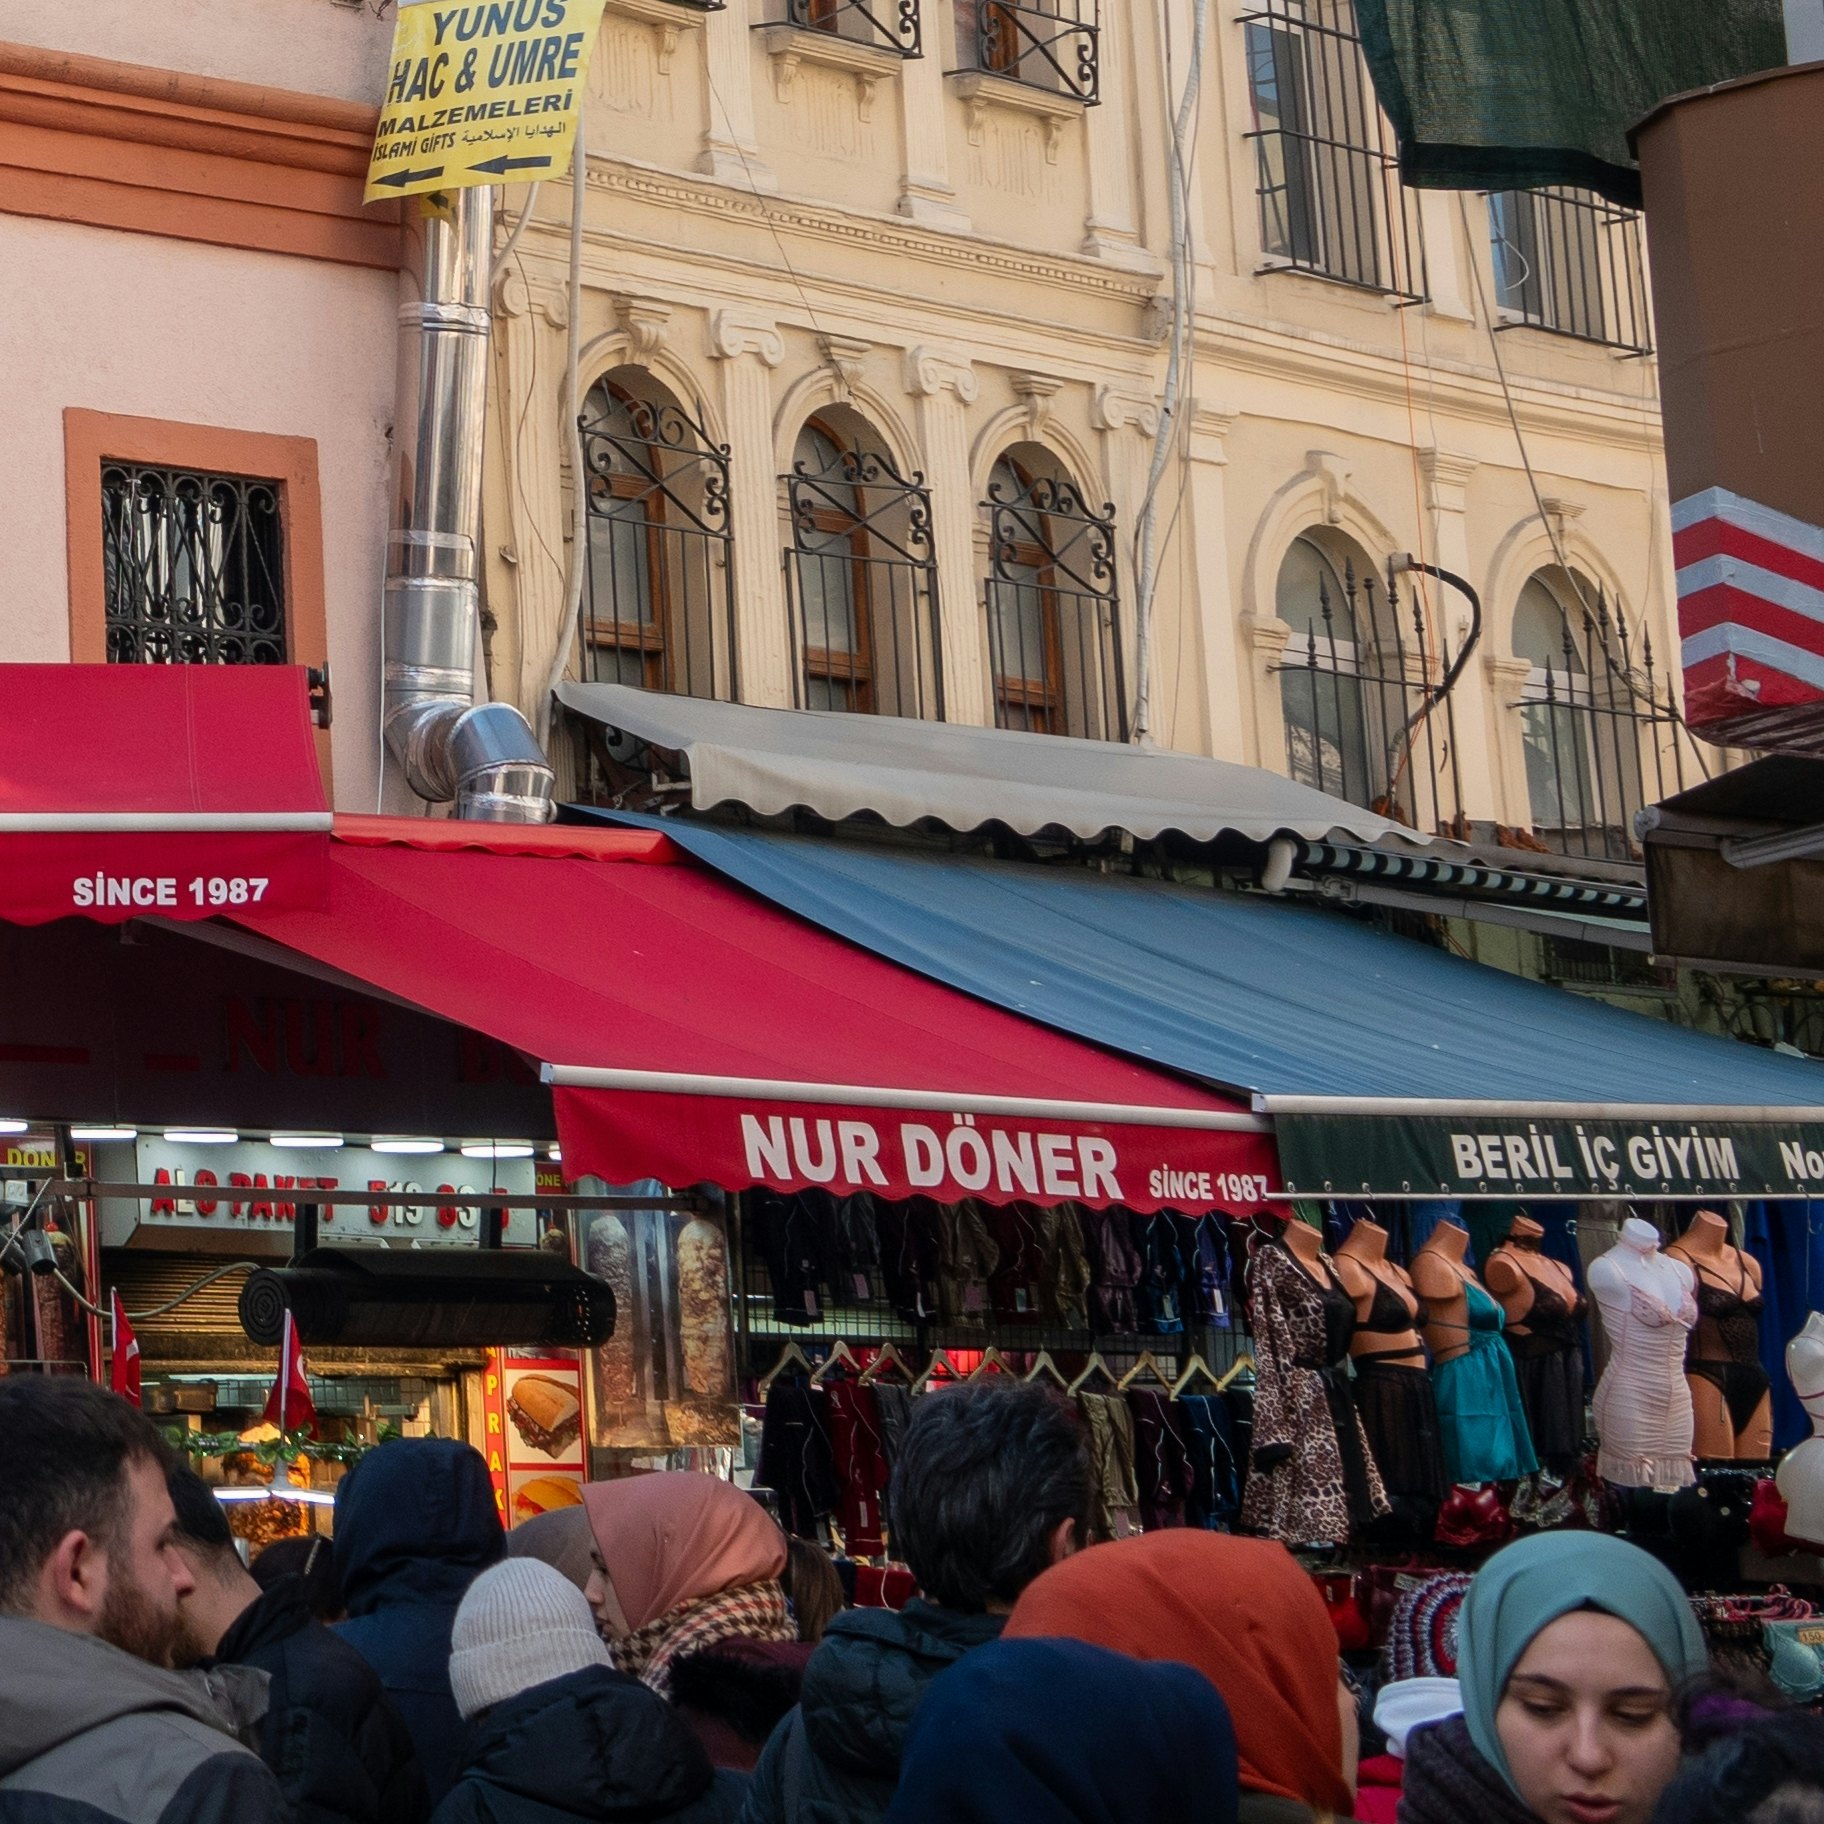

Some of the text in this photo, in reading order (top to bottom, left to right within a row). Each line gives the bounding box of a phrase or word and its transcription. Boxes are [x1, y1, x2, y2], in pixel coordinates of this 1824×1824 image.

[387, 32, 584, 105] HAC & UMRE
[378, 89, 573, 138] MALZEMELERİ
[524, 122, 566, 138] الهدايا
[372, 130, 455, 161] İSLAMİ GİFTS
[73, 869, 177, 908] SİNCE
[188, 877, 270, 906] 1987
[225, 993, 387, 1078] NUR
[739, 1111, 1270, 1203] NUR DÖNER SİNCE 1987
[1451, 1124, 1573, 1180] BERİL
[1575, 1125, 1621, 1191] İÇ
[1627, 1125, 1740, 1181] GİYİM
[151, 1167, 219, 1219] ALO
[368, 1179, 424, 1225] 519
